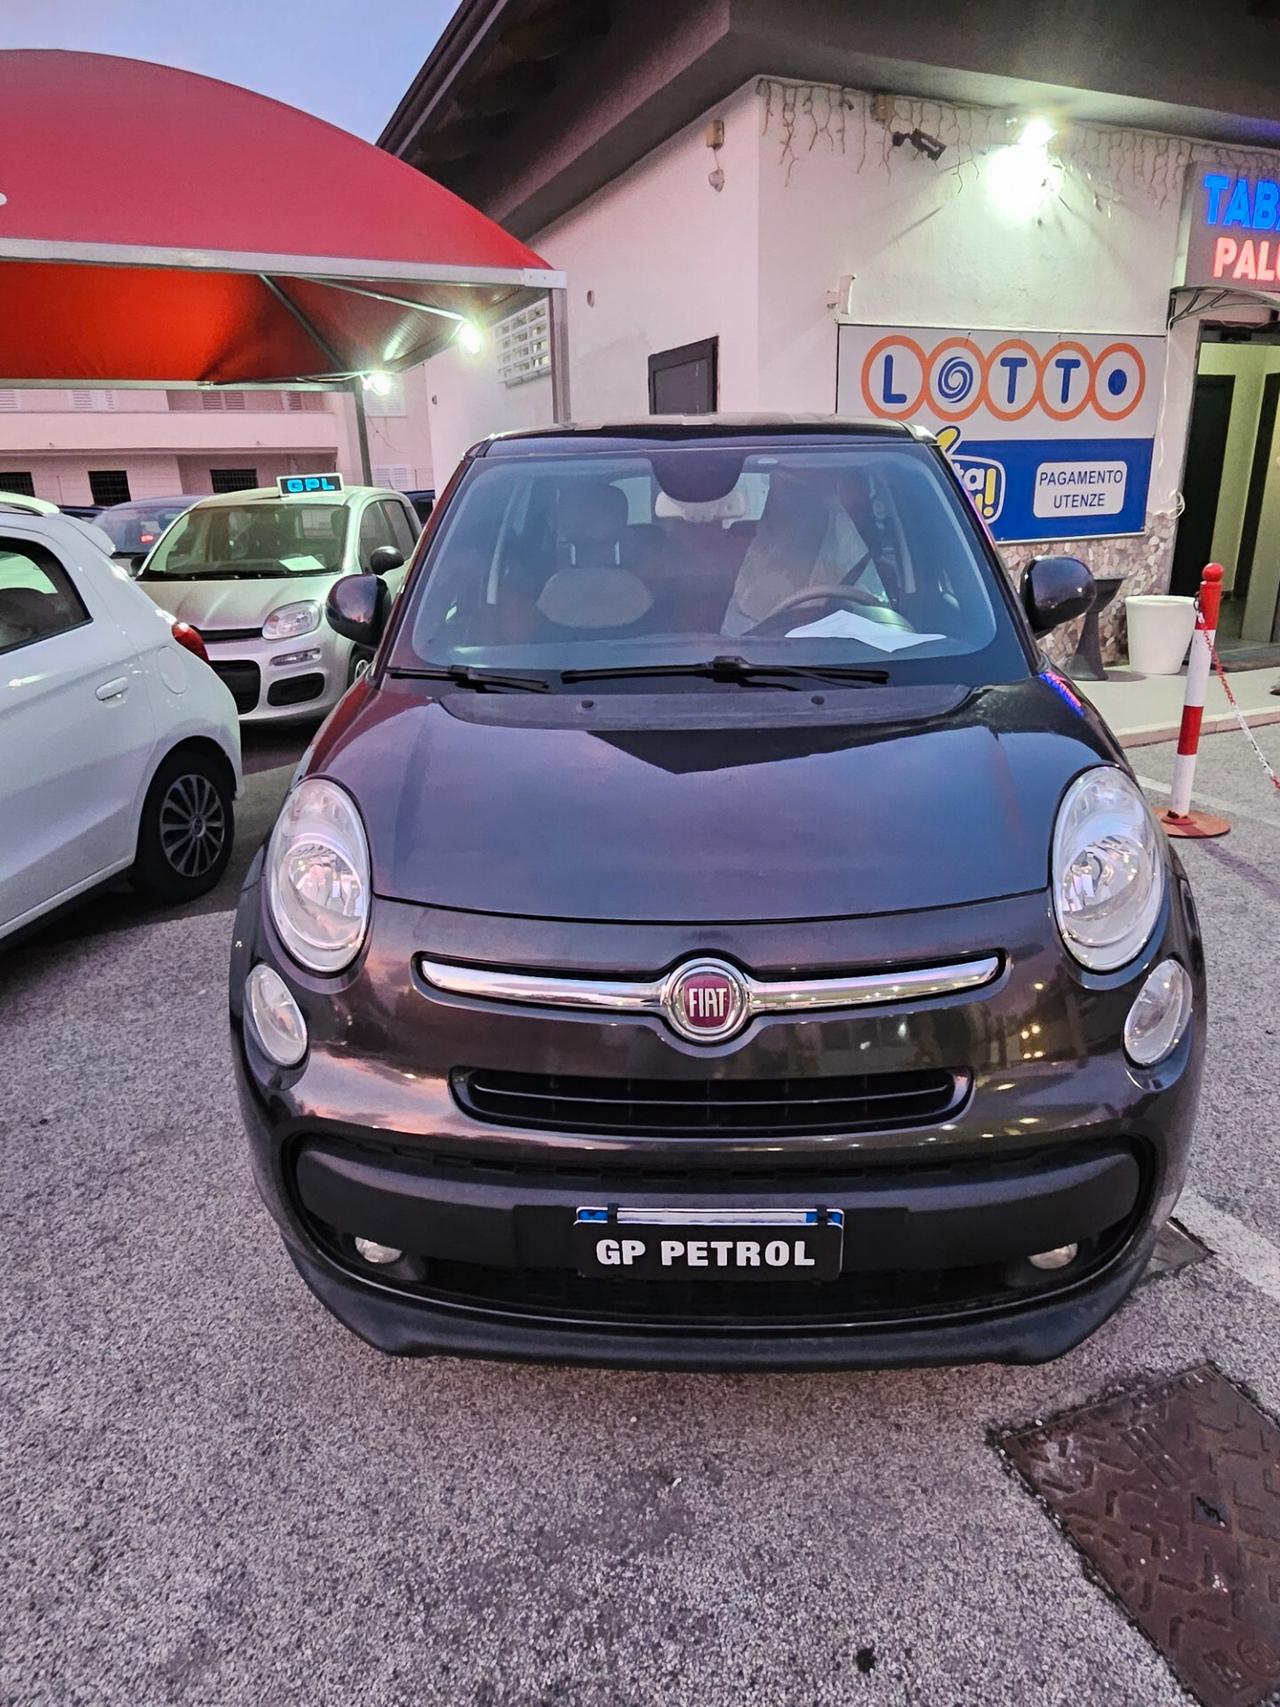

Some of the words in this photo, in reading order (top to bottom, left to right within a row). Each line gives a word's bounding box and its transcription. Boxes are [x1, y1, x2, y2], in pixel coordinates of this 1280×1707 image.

[1204, 175, 1280, 230] TAB
[1213, 237, 1280, 280] PAL
[883, 343, 1145, 420] LOTTO
[287, 478, 335, 492] GPL
[1039, 469, 1123, 486] PAGAMENTO
[1053, 492, 1106, 509] UTENZE
[688, 988, 727, 1017] FIAT
[596, 1239, 646, 1265] GP
[660, 1240, 815, 1267] PETROL
